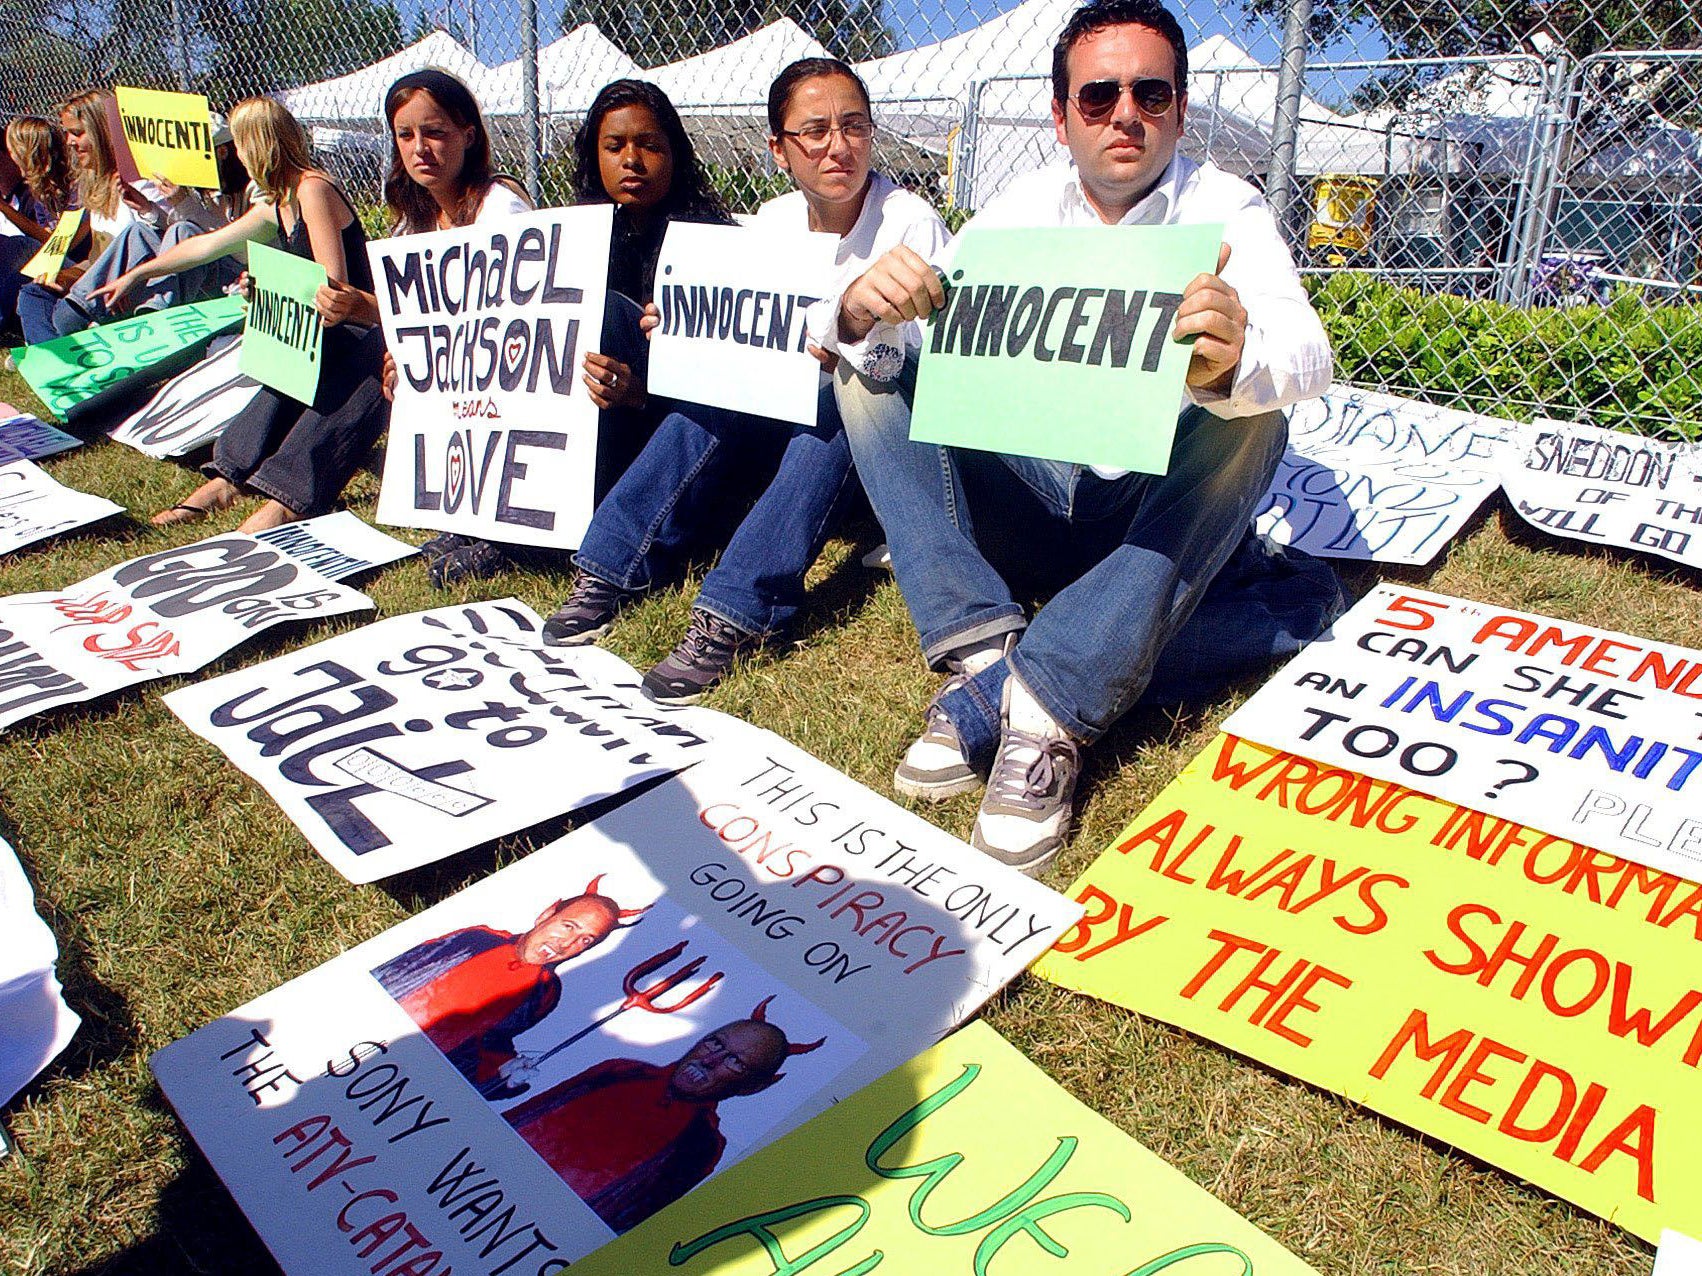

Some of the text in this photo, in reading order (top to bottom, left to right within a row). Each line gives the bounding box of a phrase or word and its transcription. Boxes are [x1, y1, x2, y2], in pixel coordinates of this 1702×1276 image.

[414, 429, 568, 531] LOVE
[1526, 432, 1677, 490] SNEDDON
[1518, 500, 1692, 555] WILL GO
[1576, 488, 1702, 525] OF TH
[113, 538, 342, 618] GOD IS
[222, 599, 298, 629] ON
[83, 621, 180, 672] SIDE
[1294, 671, 1369, 700] AN
[1356, 631, 1645, 720] CAN SHE
[444, 700, 548, 748] to
[1298, 707, 1459, 777] TOO
[1211, 733, 1430, 834] WRONG
[699, 803, 966, 976] CONSPIRACY
[740, 756, 1052, 956] THIS IS THE ONLY
[689, 862, 872, 985] GOING ON
[1117, 809, 1702, 1070] ALWAYS SHOW
[220, 1027, 304, 1107] THE
[1050, 883, 1659, 1205] BY THE MEDIA
[865, 1063, 1132, 1276] WE
